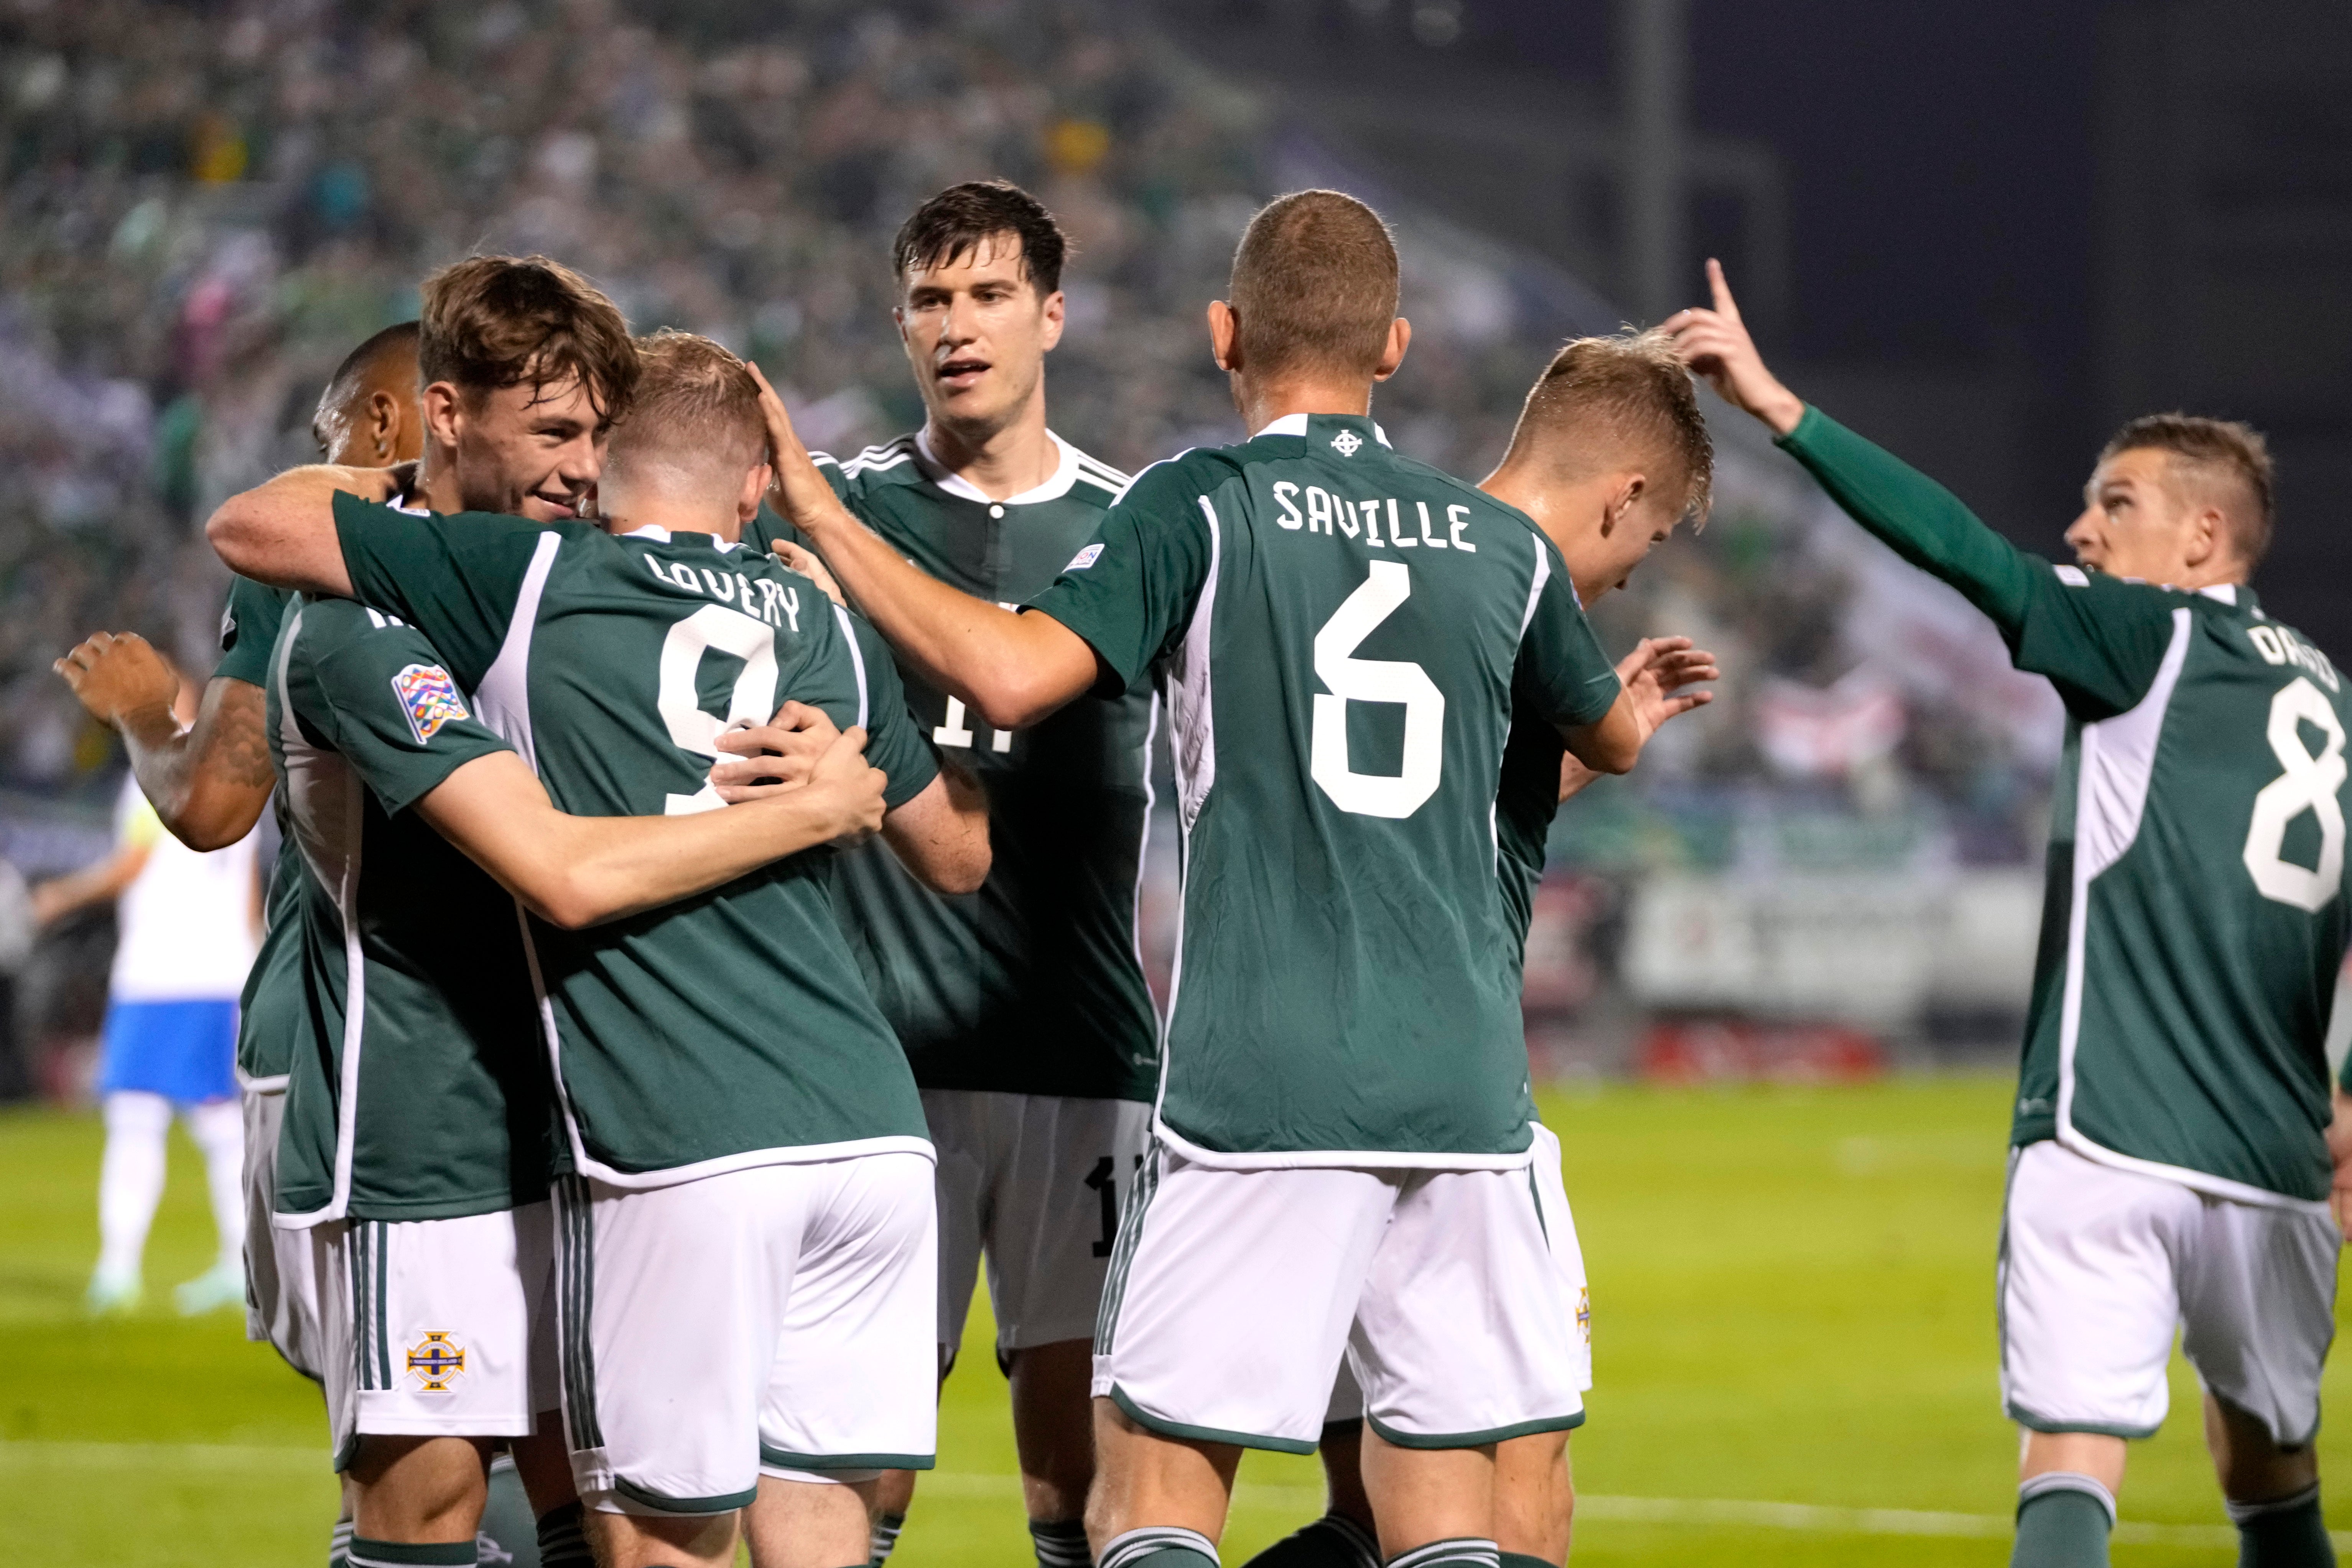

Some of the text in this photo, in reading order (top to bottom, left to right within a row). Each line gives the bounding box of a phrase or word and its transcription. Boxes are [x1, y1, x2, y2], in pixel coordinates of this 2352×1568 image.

[1273, 481, 1476, 553] SAVILLE
[657, 604, 779, 816] 9
[1311, 559, 1445, 819] 6
[2242, 676, 2347, 914] 8
